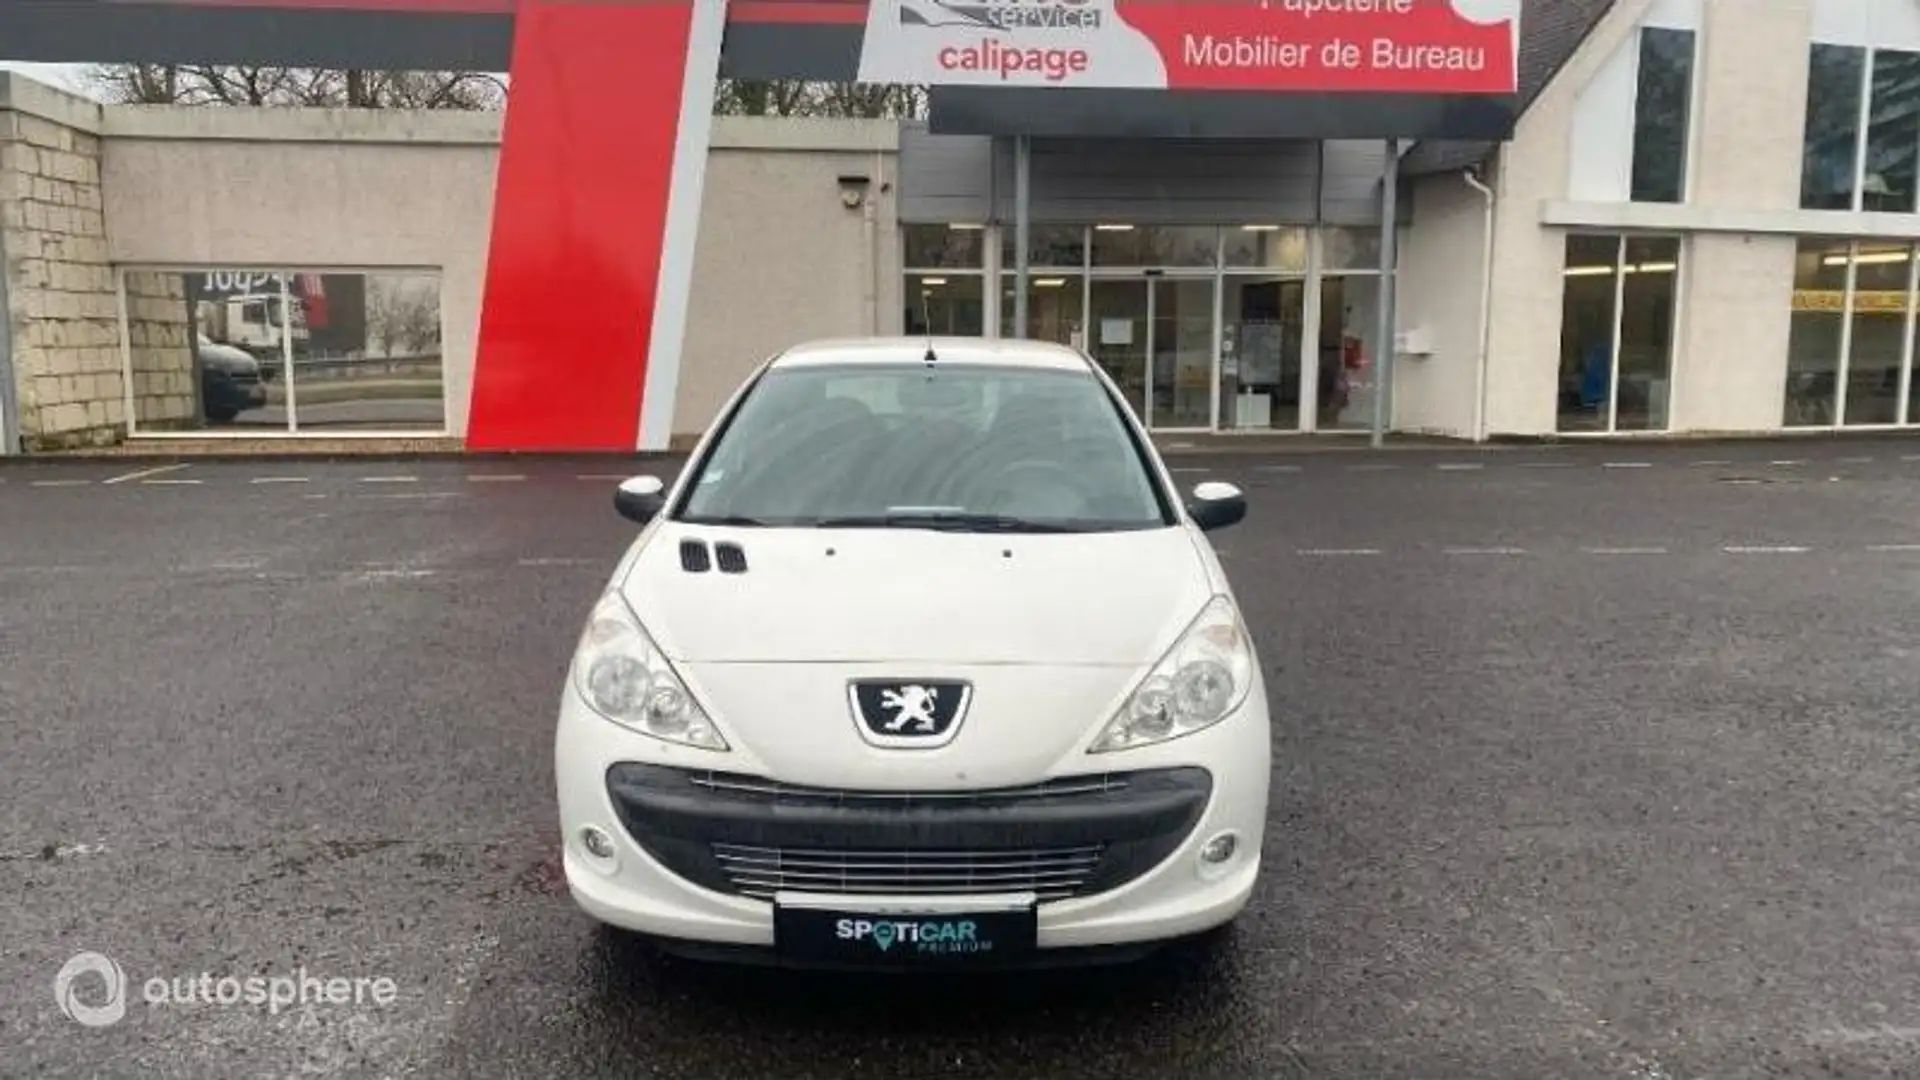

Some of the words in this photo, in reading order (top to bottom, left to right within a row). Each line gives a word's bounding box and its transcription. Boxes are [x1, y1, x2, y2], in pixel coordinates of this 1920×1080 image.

[984, 7, 1097, 27] service
[938, 37, 1088, 80] calipage
[1184, 33, 1312, 67] Mobilier
[1321, 38, 1361, 68] de
[1371, 38, 1485, 70] Bureau
